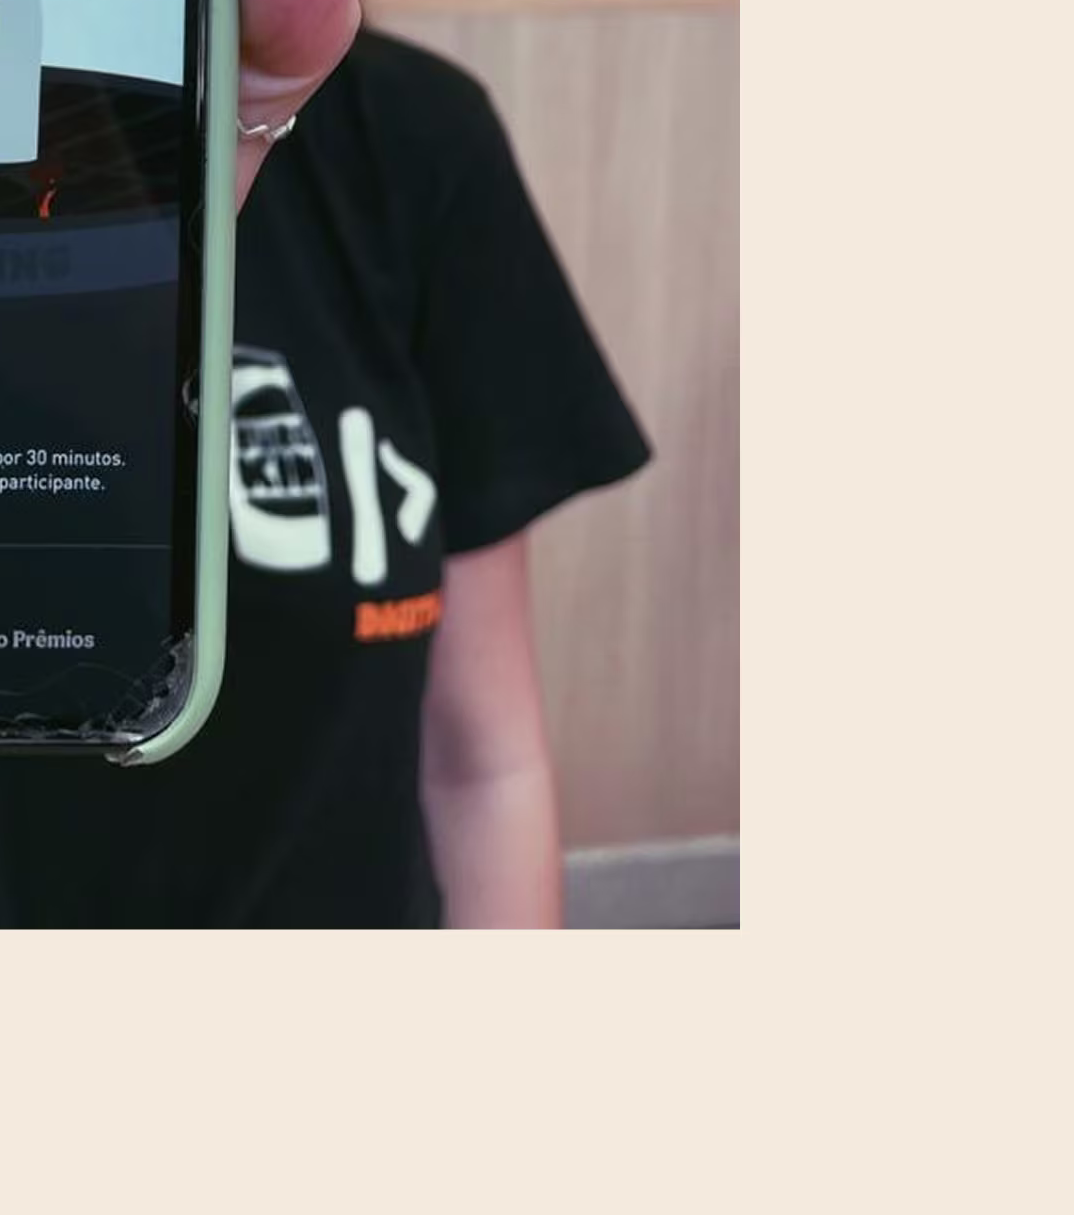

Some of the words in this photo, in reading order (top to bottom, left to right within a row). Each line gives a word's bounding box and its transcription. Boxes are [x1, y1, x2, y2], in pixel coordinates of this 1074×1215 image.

[26, 448, 48, 467] 30
[51, 449, 127, 468] minutos.
[12, 627, 95, 650] Prêmios
